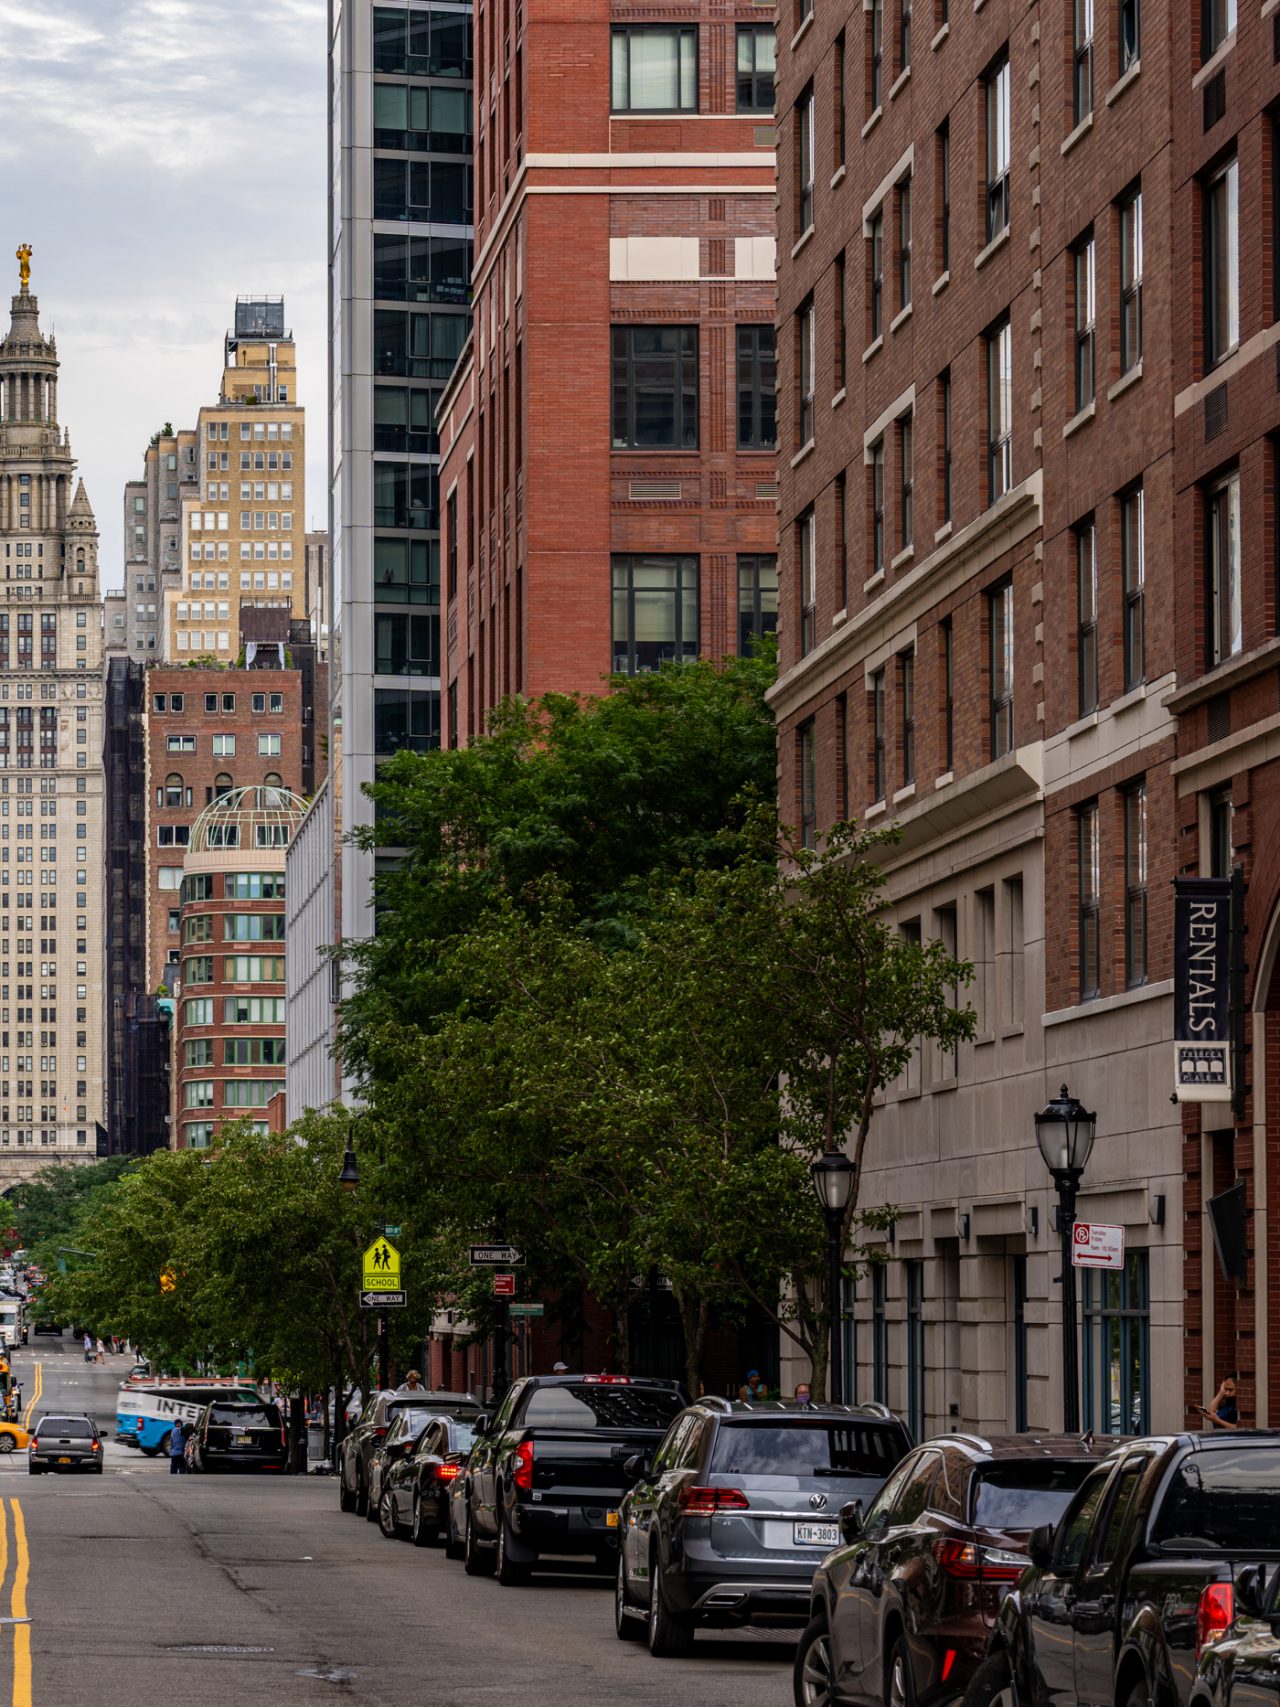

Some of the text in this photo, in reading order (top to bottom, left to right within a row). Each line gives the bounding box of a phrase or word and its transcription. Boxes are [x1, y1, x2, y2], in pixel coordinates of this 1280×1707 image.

[1188, 902, 1217, 1031] RENTALS
[1181, 1050, 1223, 1058] TRIBECA
[478, 1251, 517, 1260] ONE WAY
[366, 1279, 398, 1287] SCHOOL
